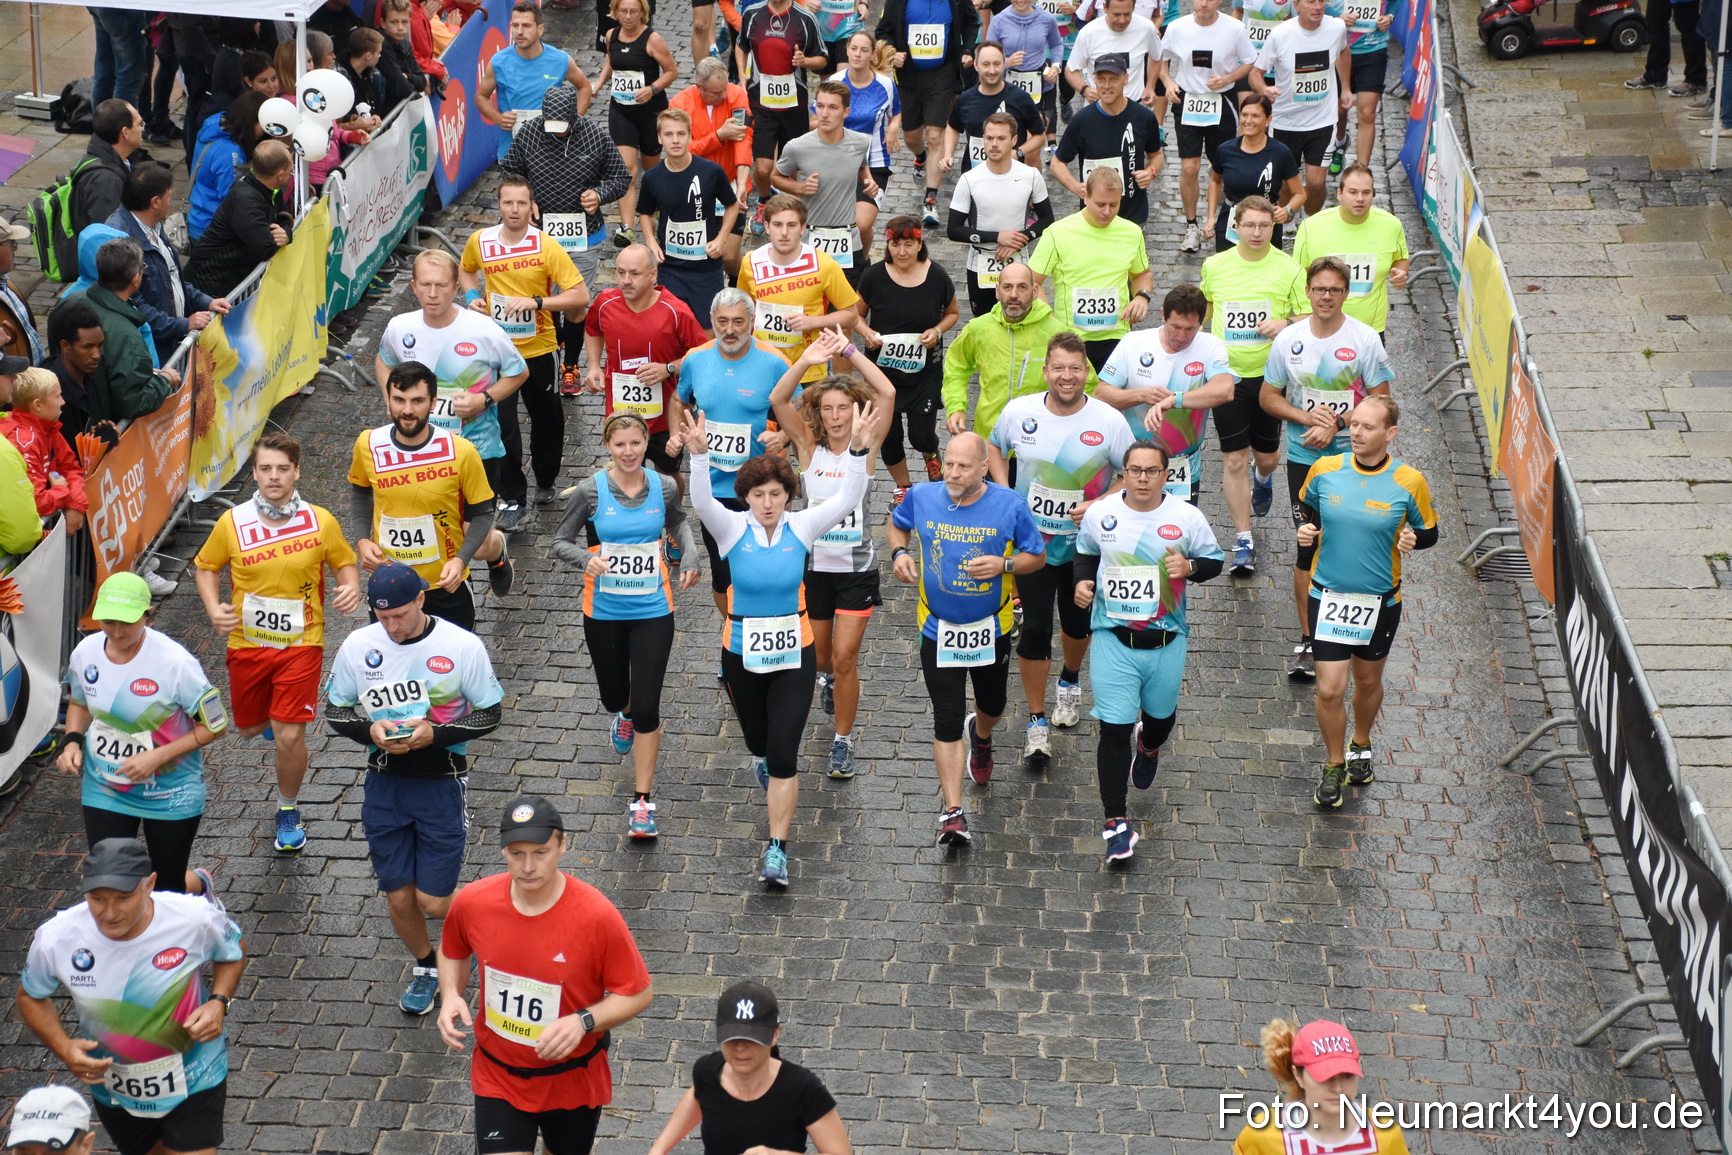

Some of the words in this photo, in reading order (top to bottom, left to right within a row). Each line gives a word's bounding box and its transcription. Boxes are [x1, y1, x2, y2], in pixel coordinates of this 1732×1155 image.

[915, 33, 938, 46] 260
[614, 78, 642, 91] 2344
[767, 83, 790, 96] 609
[1295, 78, 1328, 94] 2808
[1187, 99, 1217, 113] 3021
[438, 97, 465, 166] Hervis
[972, 146, 988, 161] 26
[547, 221, 583, 237] 2385
[669, 230, 703, 246] 2667
[813, 236, 849, 253] 2778
[676, 247, 695, 255] Stefan
[484, 263, 510, 275] MAX
[513, 257, 545, 271] BÖGL
[755, 285, 784, 299] MAX
[787, 276, 822, 292] BÖGL
[1076, 297, 1116, 315] 2333
[1087, 318, 1105, 326] Manu
[1227, 311, 1267, 329] 2392
[768, 333, 788, 343] Moritz
[1232, 332, 1261, 340] Christian
[885, 342, 923, 360] 3044
[880, 357, 919, 371] SIGRID
[622, 384, 653, 403] 233
[1306, 398, 1350, 416] 222
[706, 431, 746, 454] 2278
[1021, 435, 1037, 443] PARTL
[1083, 433, 1102, 442] Hervis
[711, 455, 736, 466] Werner
[377, 473, 411, 490] MAX
[415, 465, 459, 485] BÖGL
[1031, 495, 1079, 518] 2044
[926, 520, 936, 531] 10.
[936, 522, 998, 537] NEUMARKTER
[1041, 519, 1063, 531] Oskar
[1161, 528, 1181, 536] Hervis
[388, 528, 425, 548] 294
[820, 532, 850, 542] Sylvana
[934, 531, 985, 544] STADTLAUF
[241, 548, 279, 568] MAX
[282, 537, 323, 557] BÖGL
[395, 550, 424, 560] Roland
[606, 555, 656, 575] 2584
[615, 579, 645, 588] Kristina
[1107, 579, 1156, 600] 2524
[1121, 604, 1140, 614] Marc
[1324, 601, 1375, 627] 2427
[254, 609, 293, 633] 295
[254, 630, 292, 644] Johannes
[749, 628, 797, 652] 2585
[943, 627, 992, 649] 2038
[1332, 626, 1361, 639] Norbert
[761, 654, 786, 666] Margit
[952, 652, 982, 661] Norbert
[430, 660, 452, 672] Hervis
[133, 682, 157, 693] Hervis
[366, 679, 422, 708] 3109
[70, 975, 97, 983] PARTL
[498, 988, 544, 1023] 116
[736, 999, 755, 1020] NY
[502, 1019, 532, 1038] Alfred
[1311, 1036, 1354, 1057] NIKE
[111, 1071, 176, 1099] 2651
[132, 1101, 157, 1112] Toni
[21, 1110, 64, 1122] saller
